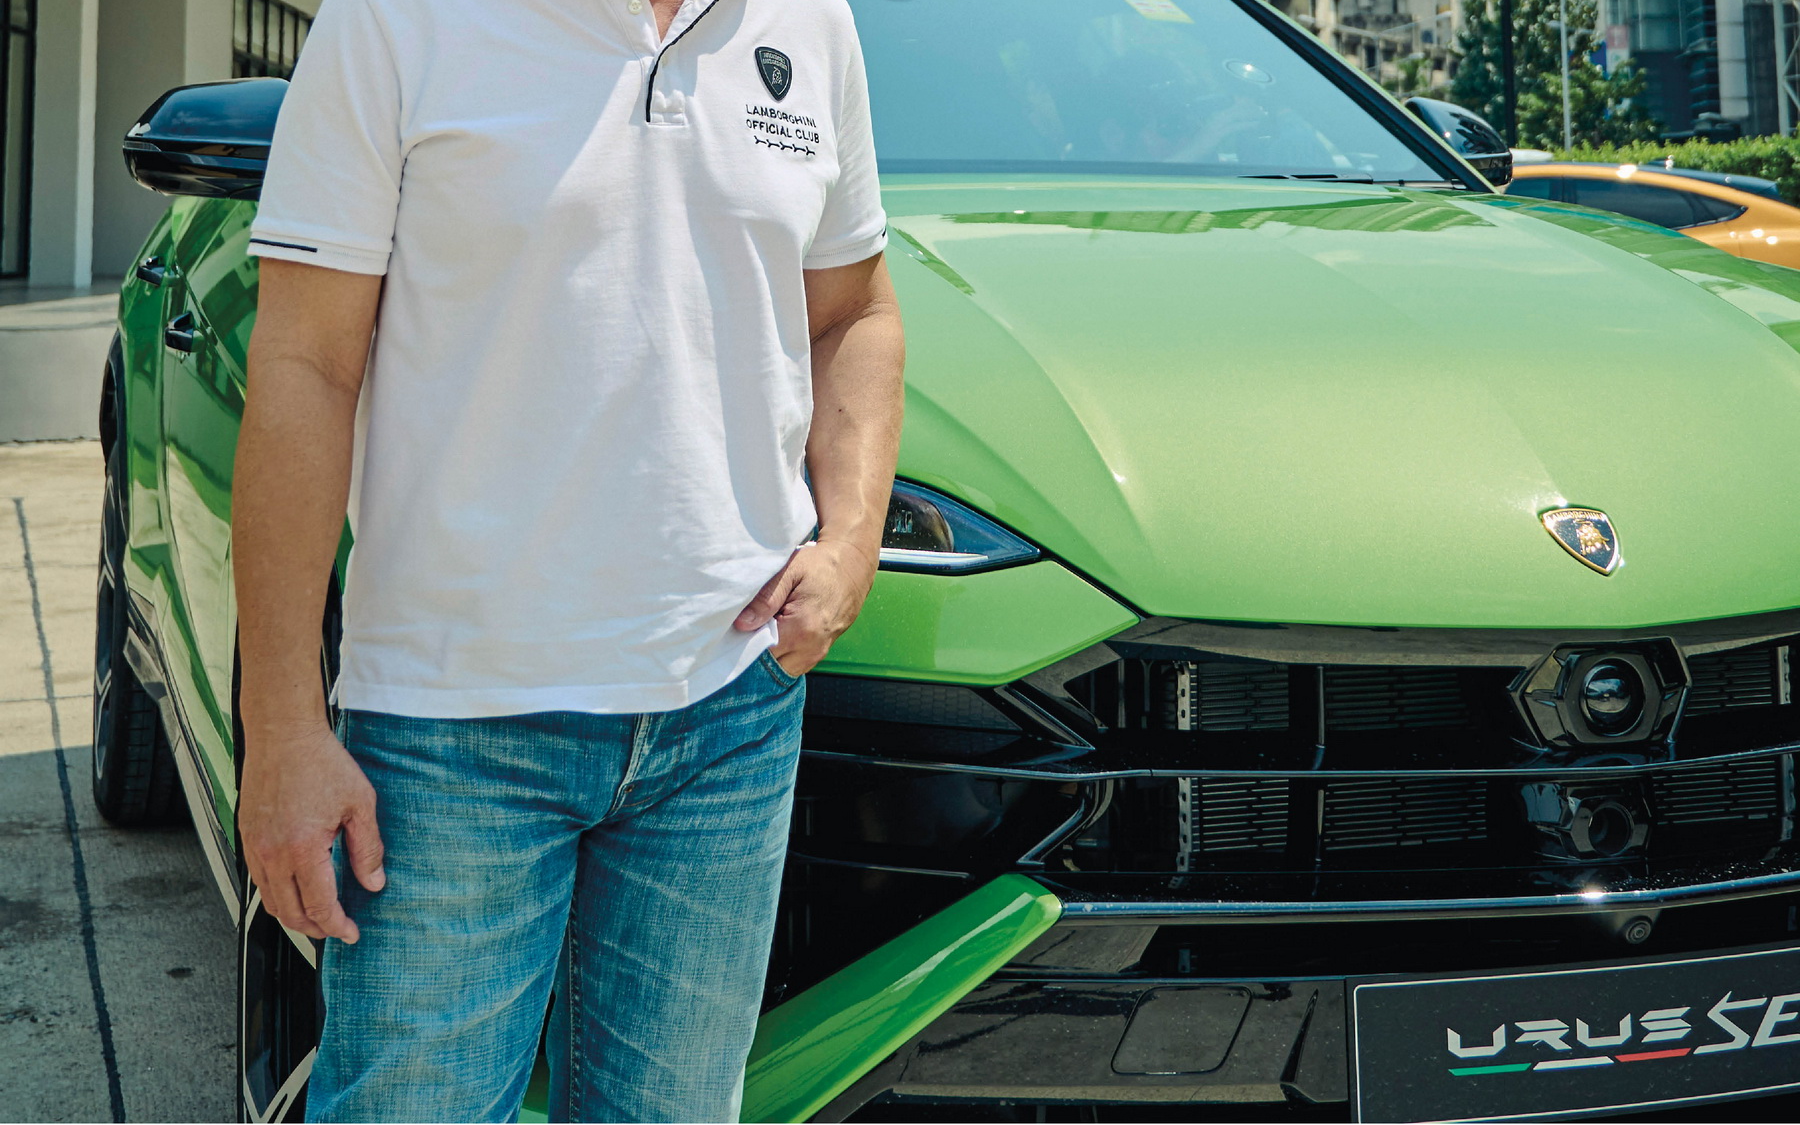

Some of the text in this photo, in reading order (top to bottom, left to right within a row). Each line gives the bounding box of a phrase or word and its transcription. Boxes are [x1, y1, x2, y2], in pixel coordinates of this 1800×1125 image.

[746, 104, 817, 128] LAMBORGHINI
[746, 119, 820, 144] OFFICIAL CLUB
[1447, 991, 1800, 1058] URUS SE
